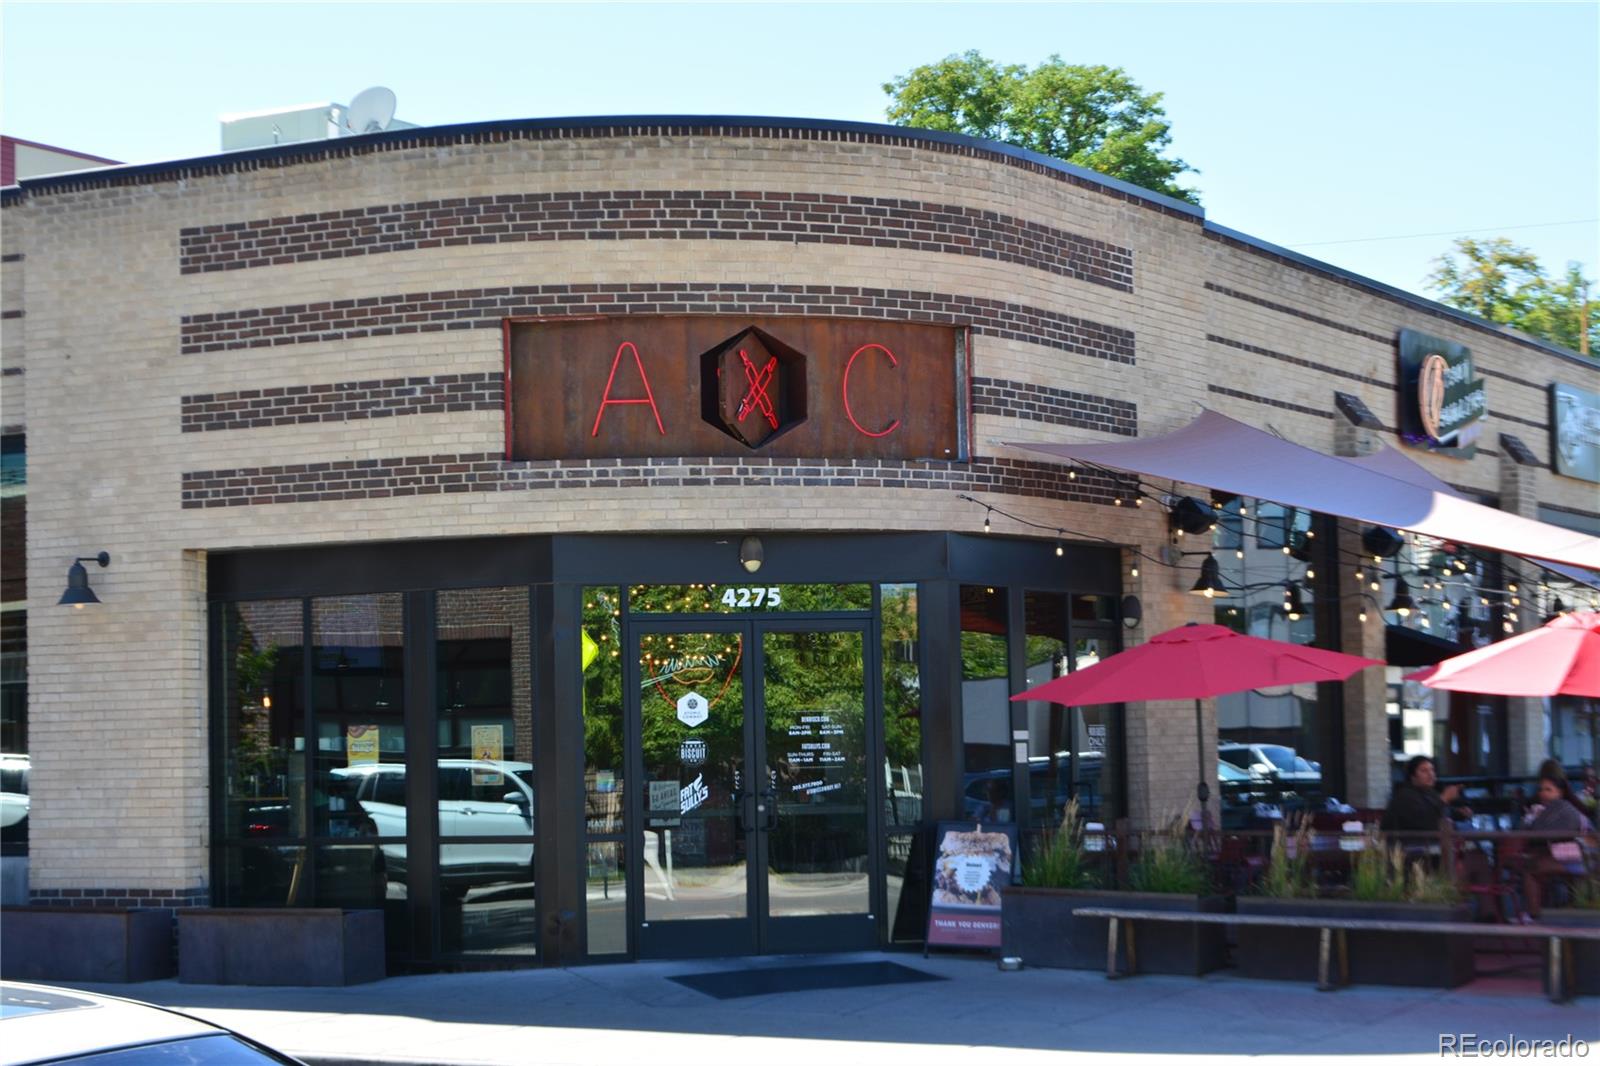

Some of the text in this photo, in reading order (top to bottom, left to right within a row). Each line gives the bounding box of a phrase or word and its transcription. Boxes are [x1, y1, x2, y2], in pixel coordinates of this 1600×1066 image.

[722, 587, 781, 607] 4275
[680, 747, 706, 759] BISCUIT
[680, 783, 695, 802] FAT
[935, 920, 956, 928] THANK
[958, 920, 972, 928] YOU
